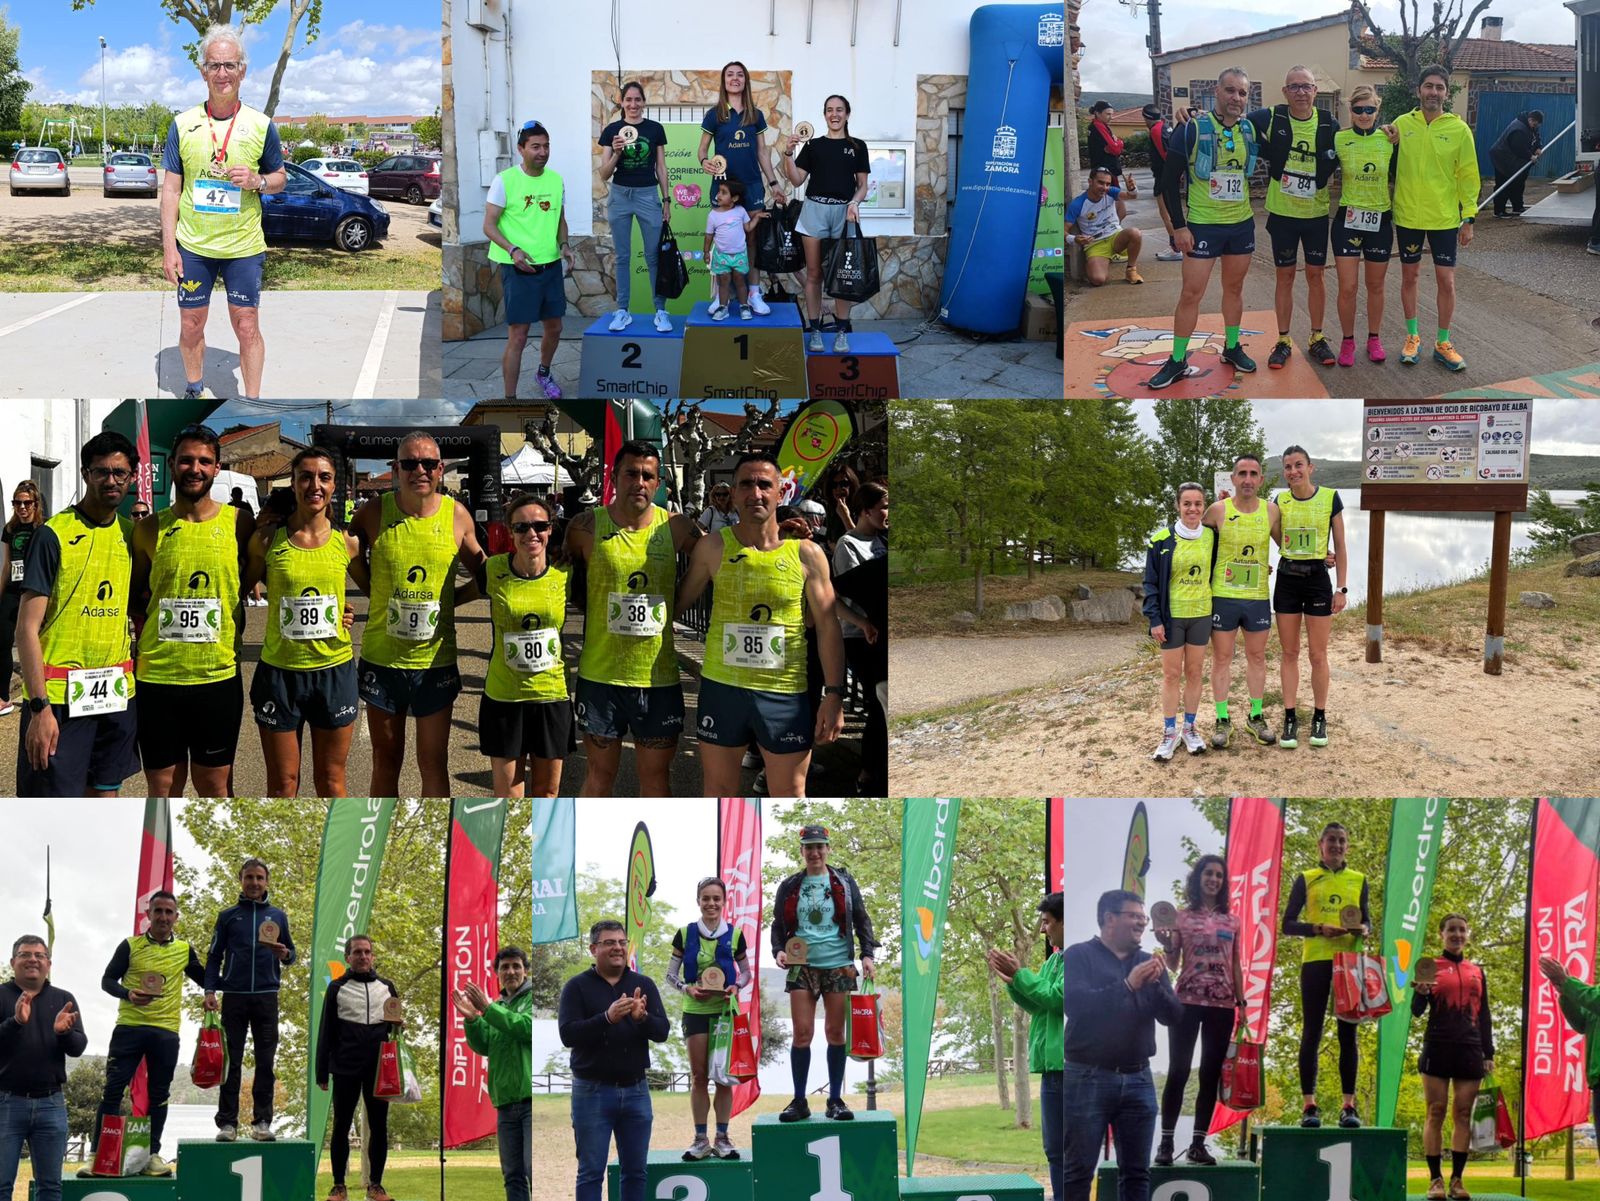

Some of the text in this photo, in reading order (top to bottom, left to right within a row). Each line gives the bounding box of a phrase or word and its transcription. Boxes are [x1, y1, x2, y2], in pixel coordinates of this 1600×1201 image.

[984, 165, 1020, 174] ZAMORA
[1355, 174, 1380, 182] Adarsa
[1226, 179, 1242, 193] 132
[1297, 175, 1312, 191] 84
[206, 189, 227, 204] 47
[676, 188, 688, 196] WE
[677, 195, 697, 203] LOVE
[1360, 211, 1378, 225] 136
[621, 342, 643, 369] 2
[733, 334, 749, 361] 1
[839, 356, 861, 381] 3
[597, 379, 668, 398] SmartChip
[815, 383, 889, 399] SmartChip
[1367, 402, 1528, 416] BIENVENIDOS A LA ZONA DE OCIO DE RICOBAYO DE ALBA
[1298, 533, 1311, 547] 11
[1178, 577, 1203, 586] Adarsa
[1246, 569, 1251, 582] 1
[393, 588, 434, 600] Adarsa
[180, 610, 199, 628] 95
[300, 607, 319, 626] 89
[409, 612, 419, 629] 9
[628, 605, 647, 623] 38
[525, 641, 543, 660] 80
[744, 635, 764, 654] 85
[89, 679, 108, 700] 44
[334, 798, 382, 953] Iberdrola
[1563, 889, 1590, 1093] ZAORA
[806, 1135, 854, 1201] 1
[1317, 1142, 1356, 1201] 1
[231, 1155, 262, 1201] 1
